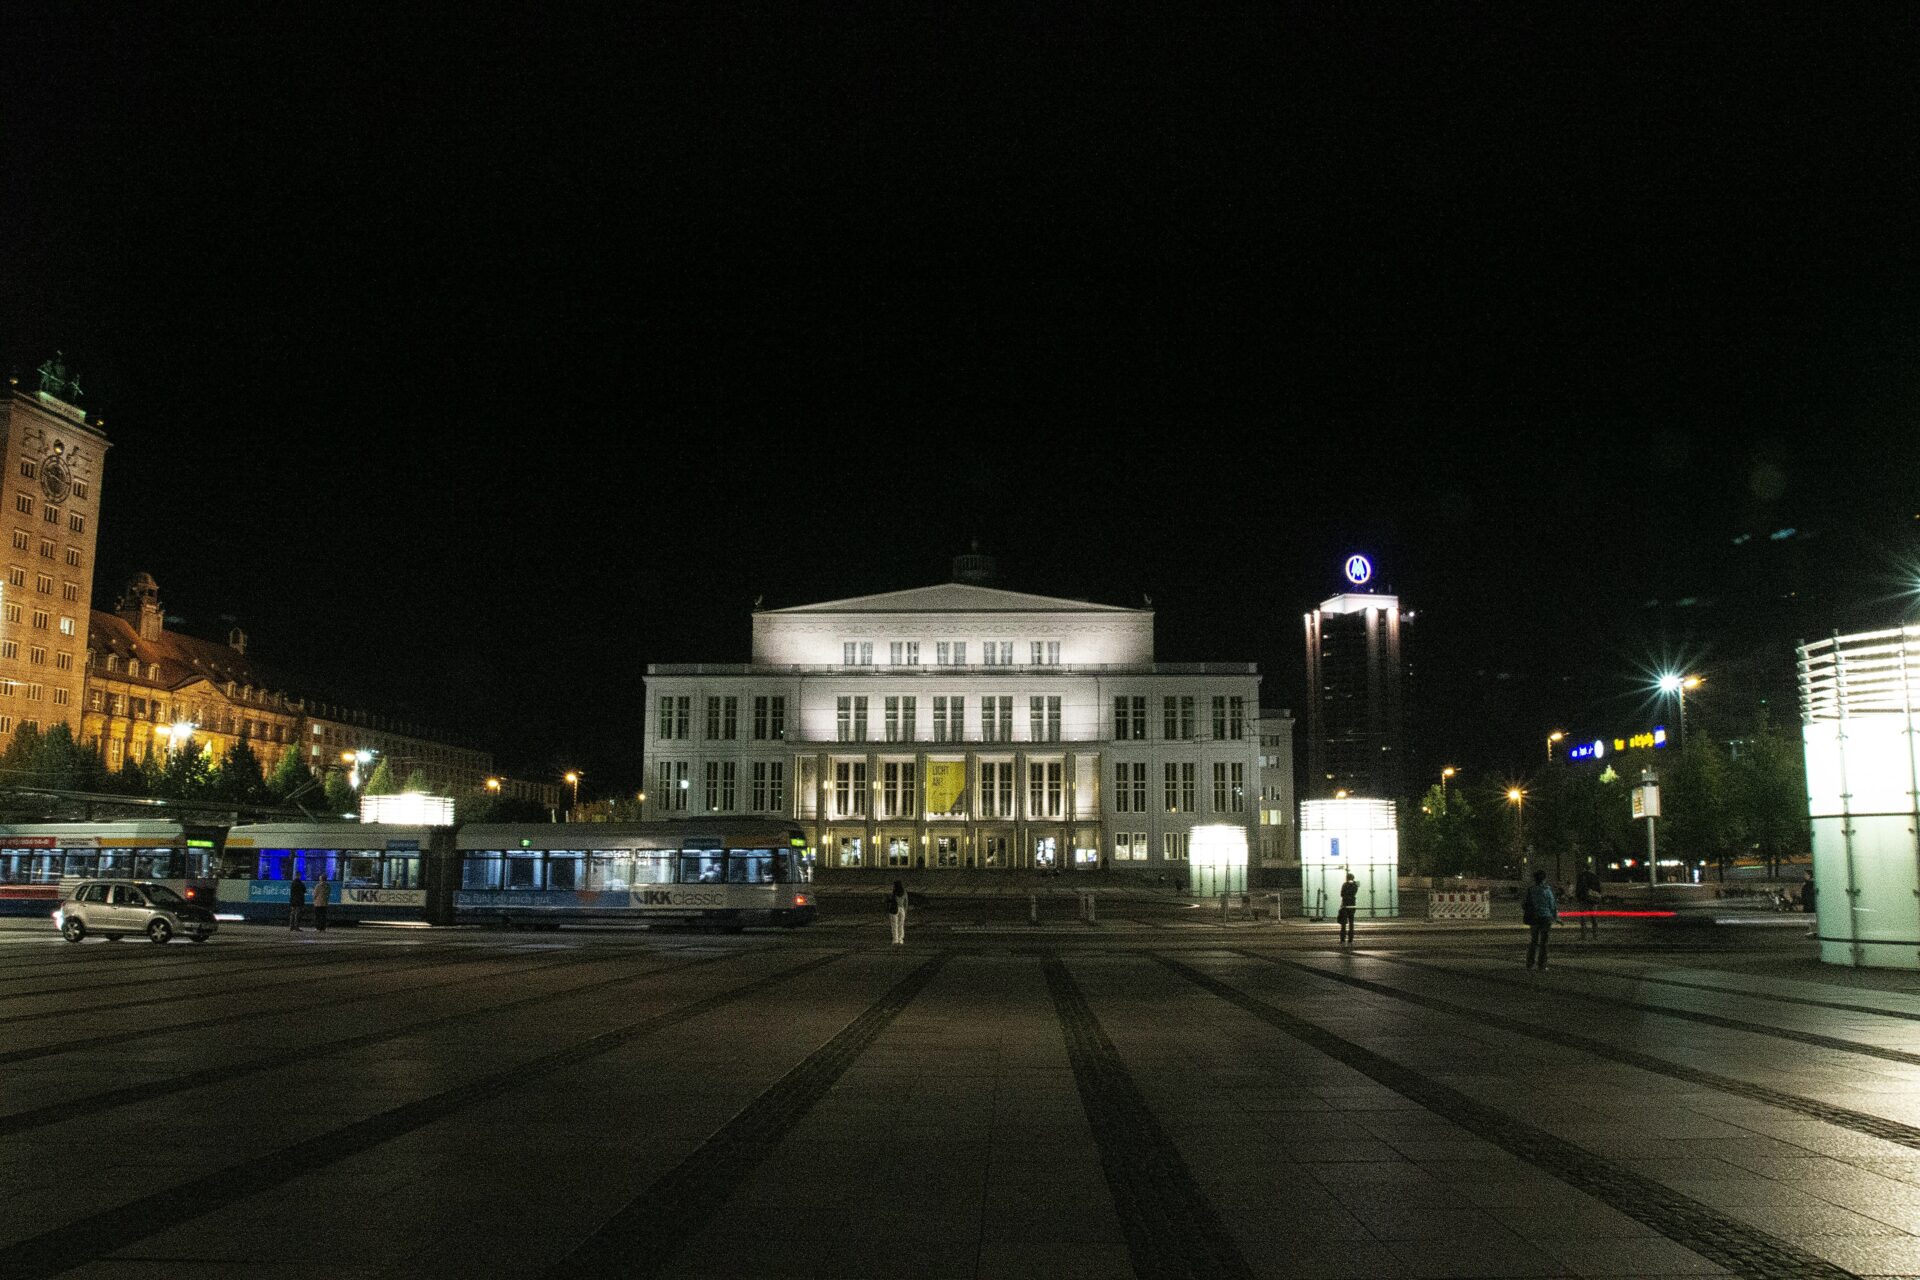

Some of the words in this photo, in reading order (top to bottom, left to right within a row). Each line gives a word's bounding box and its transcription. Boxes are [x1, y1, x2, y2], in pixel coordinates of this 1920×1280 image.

[357, 890, 378, 902] IKK
[379, 891, 418, 903] classic
[643, 891, 671, 905] IKK
[672, 891, 723, 905] classic
